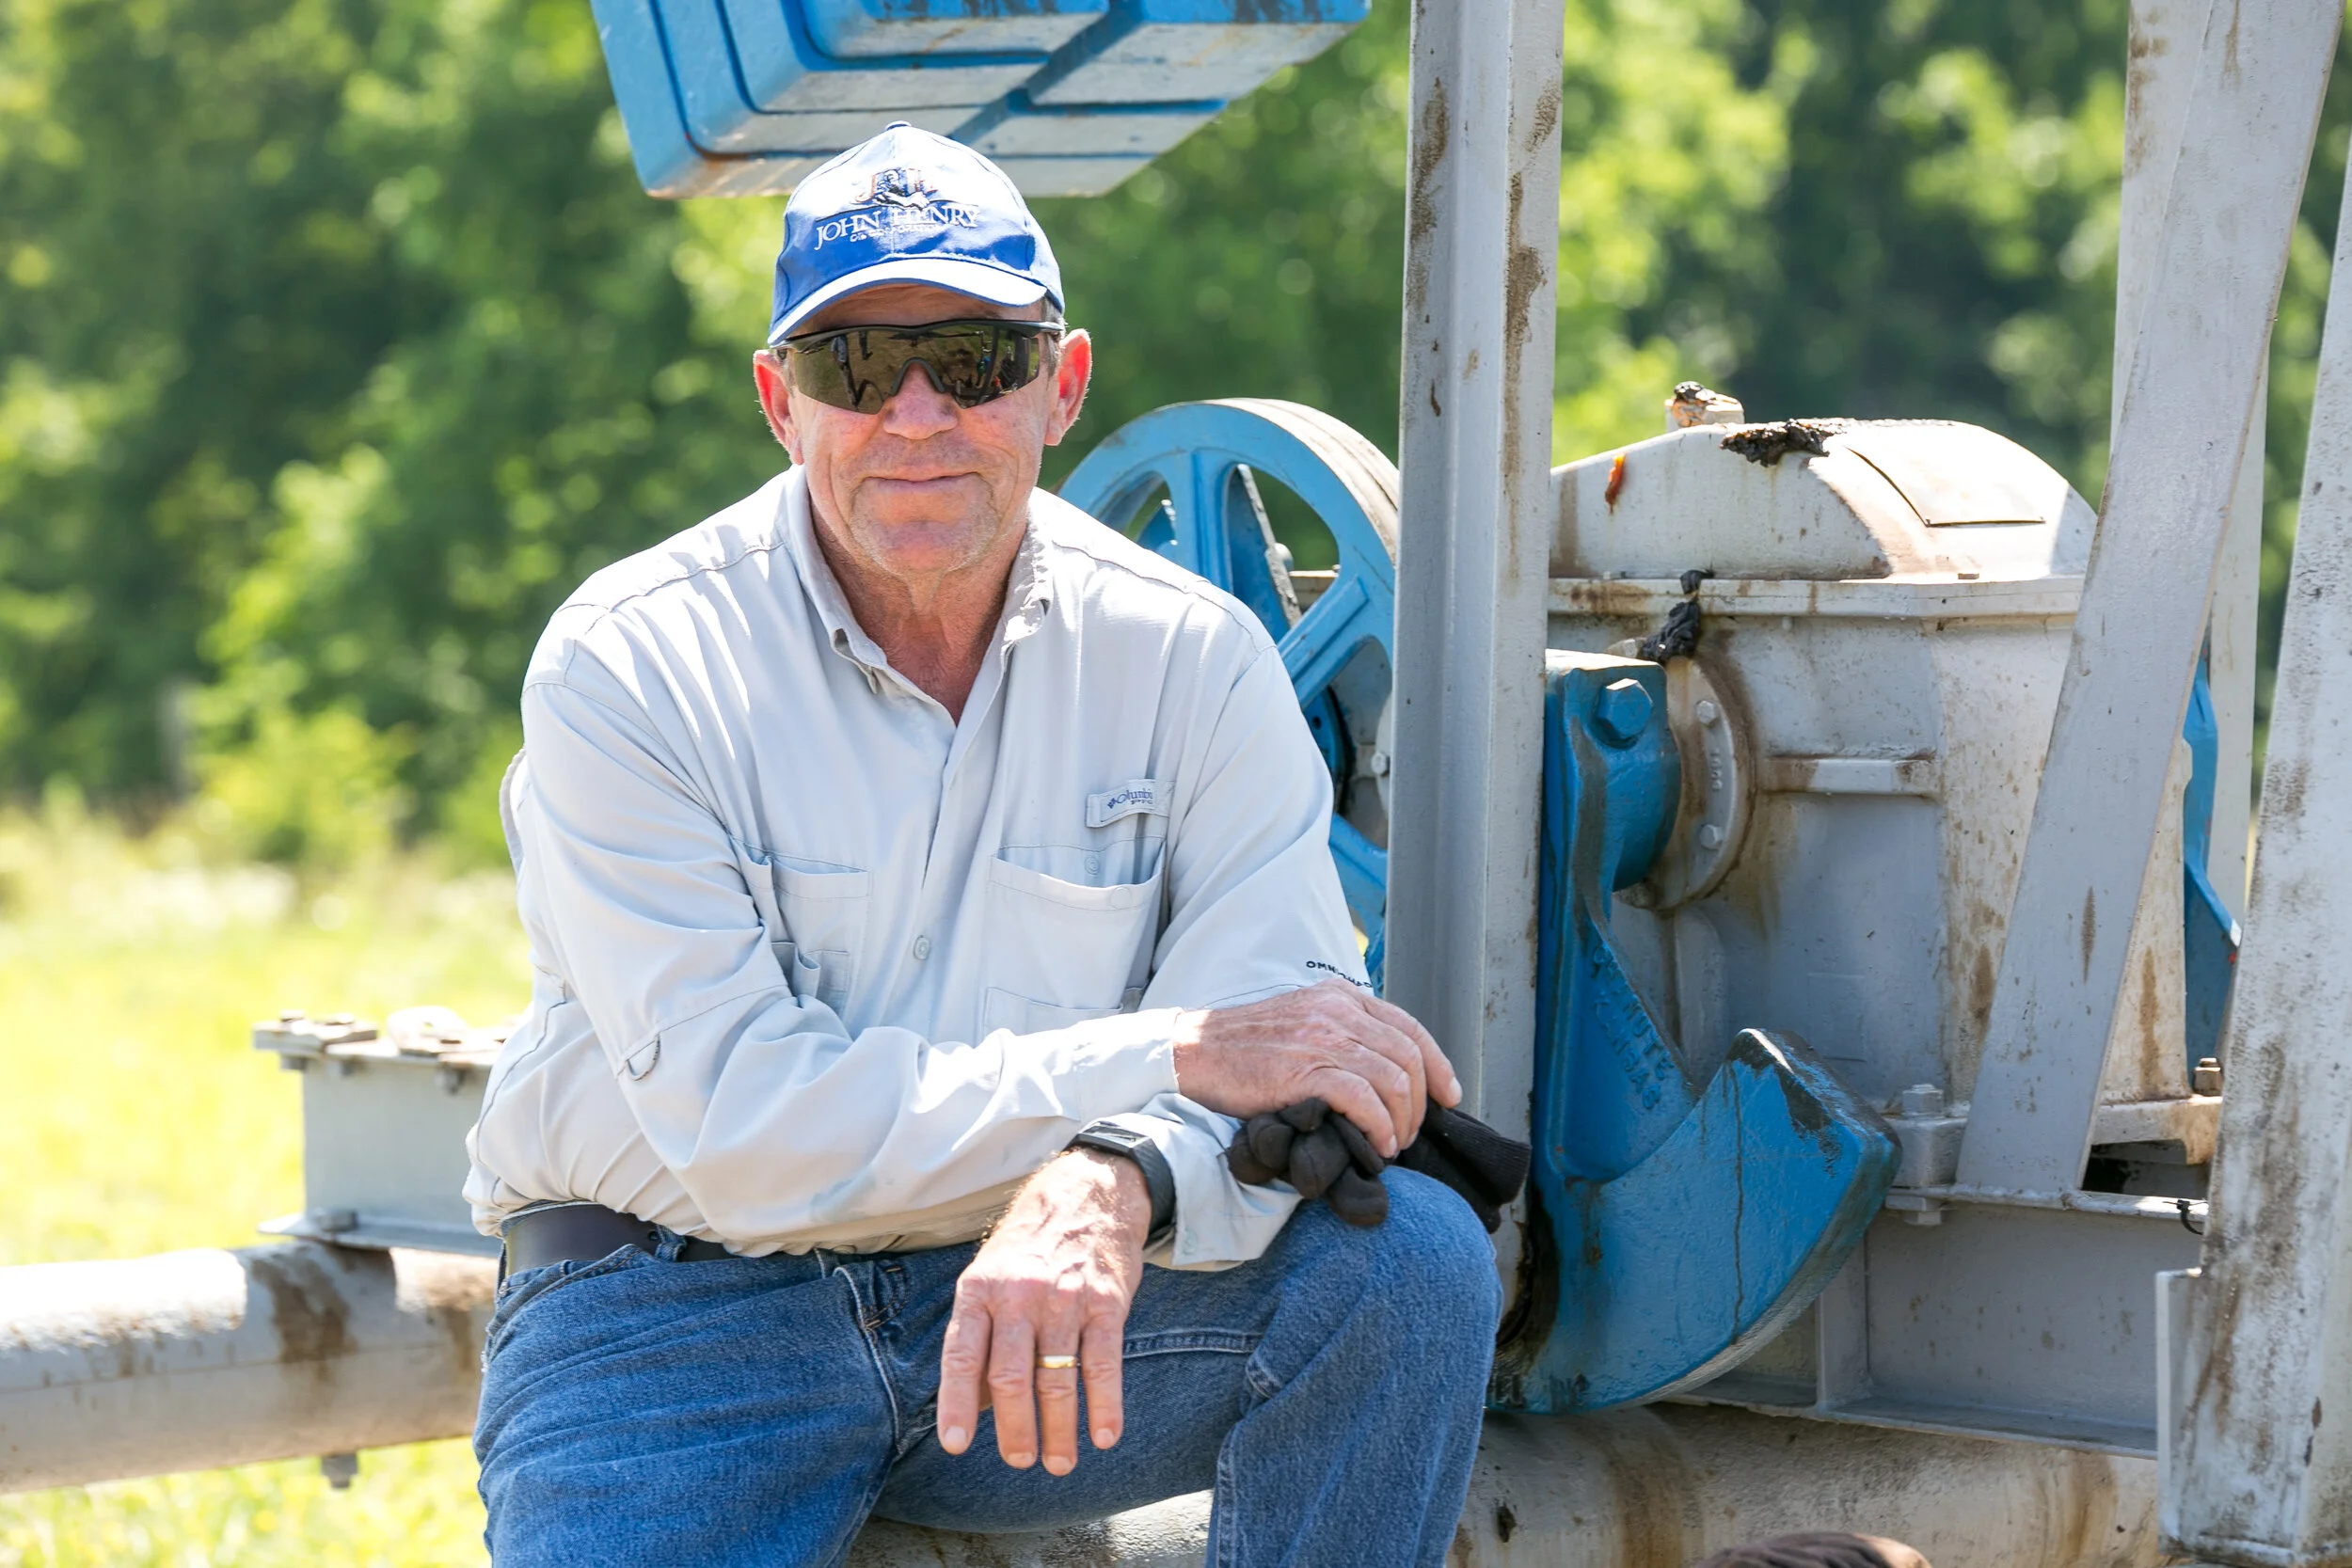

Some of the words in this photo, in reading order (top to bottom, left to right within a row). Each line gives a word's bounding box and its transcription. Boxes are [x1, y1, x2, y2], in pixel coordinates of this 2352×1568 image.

[814, 210, 882, 250] JOHN
[891, 204, 980, 228] HENRY
[1116, 788, 1154, 804] Columbi
